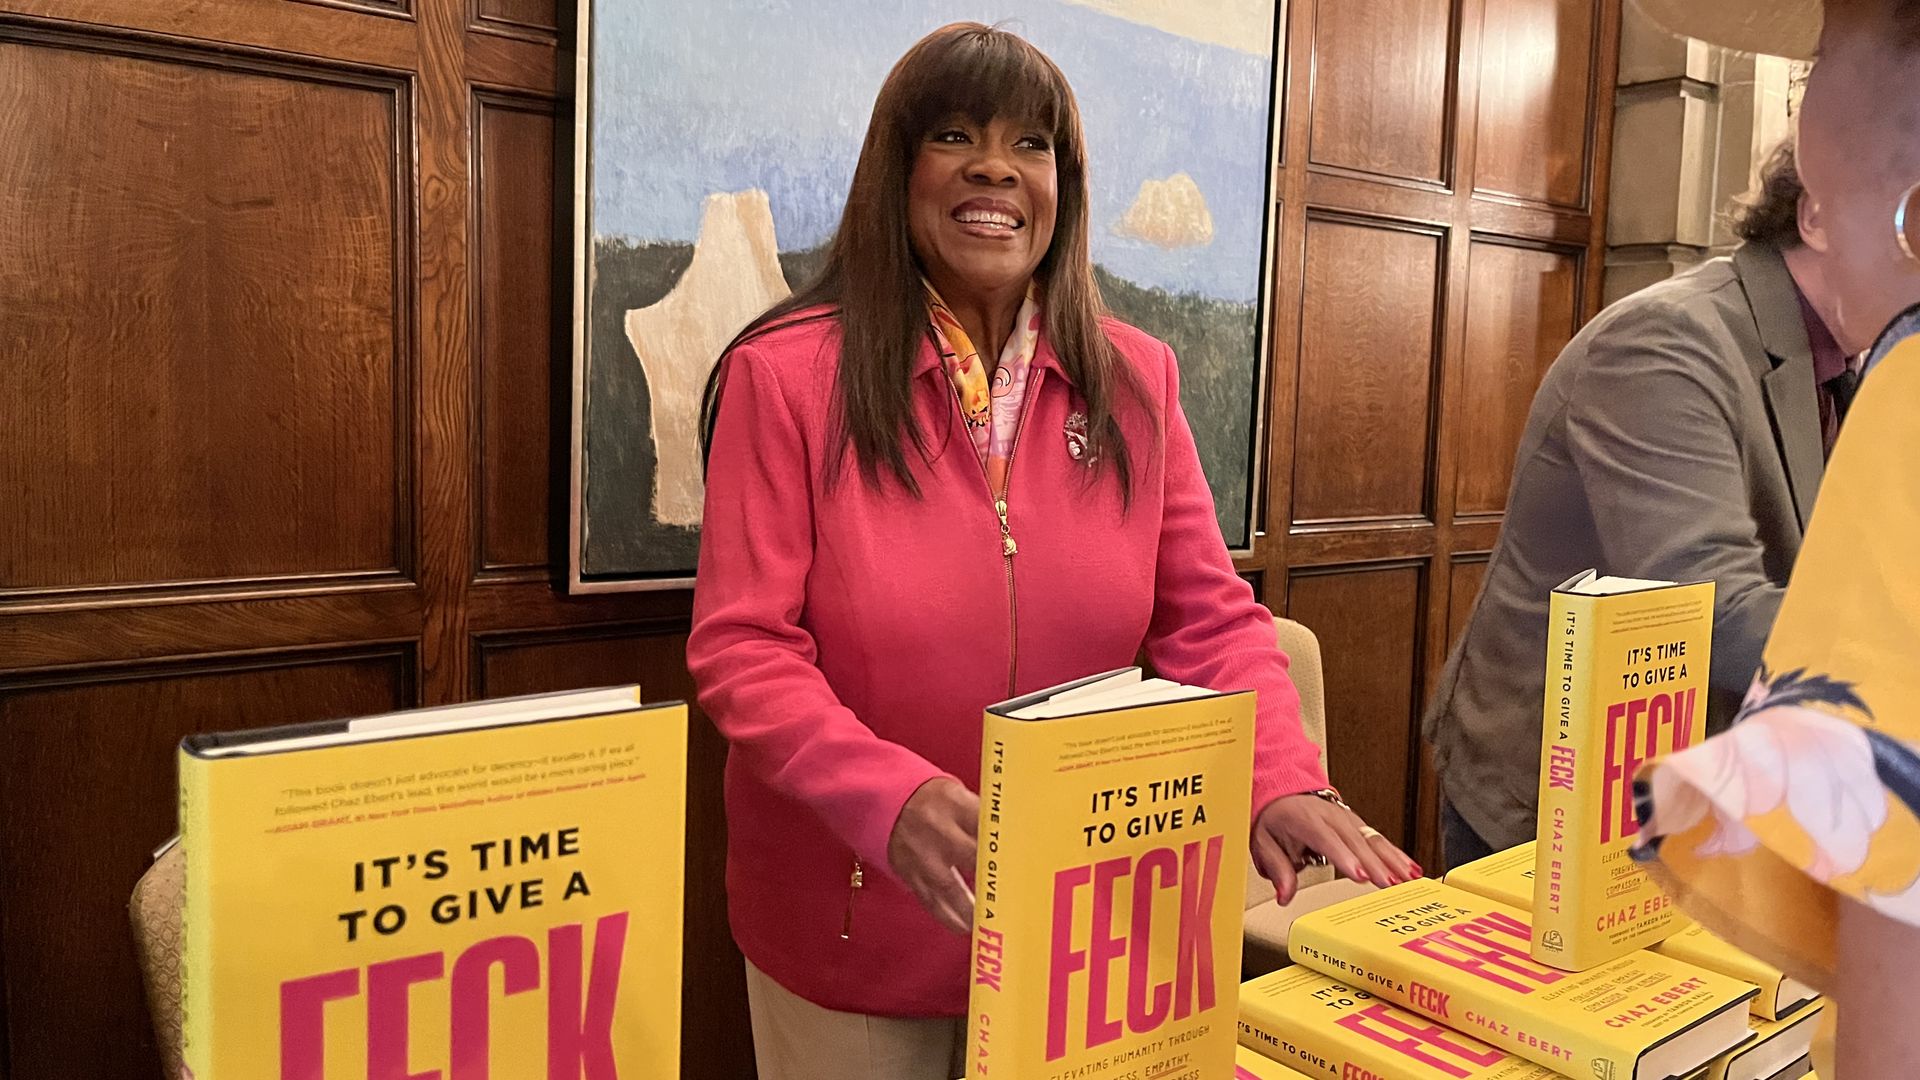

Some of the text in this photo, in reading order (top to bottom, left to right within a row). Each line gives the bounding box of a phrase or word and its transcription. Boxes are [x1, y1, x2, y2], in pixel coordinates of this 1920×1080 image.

[1627, 640, 1686, 666] IT'S TIME
[1623, 663, 1687, 690] TO GIVE A
[1549, 611, 1576, 914] IT'S TIME TO GIVE A FECK CHAZ EBERT
[1091, 774, 1203, 814] IT'S TIME
[1084, 804, 1207, 847] TO GIVE A
[354, 827, 580, 893] IT'S TIME
[337, 871, 591, 943] TO GIVE A
[975, 741, 1004, 1076] IT'S TIME TO GIVE A FECK CHAZ
[1376, 914, 1405, 927] IT'S
[1406, 902, 1448, 917] TIME
[1391, 907, 1472, 935] TO GIVE A
[1597, 904, 1637, 932] CHAZ
[1644, 894, 1671, 916] EBE
[1045, 834, 1224, 1063] FECK
[1300, 944, 1573, 1062] IT'S TIME TO GIVE A FECK CHAZ EBERT
[1311, 984, 1348, 1000] IT'S
[1326, 998, 1354, 1010] TO
[1605, 1003, 1658, 1028] CHAZ
[1651, 977, 1708, 1005] EBERT
[1113, 1040, 1165, 1067] HUMANITY
[1168, 1024, 1210, 1046] THROUGH
[1254, 1028, 1278, 1046] TIME
[1282, 1041, 1296, 1054] TO
[1300, 1050, 1326, 1069] GIVE
[1330, 1064, 1337, 1075] A
